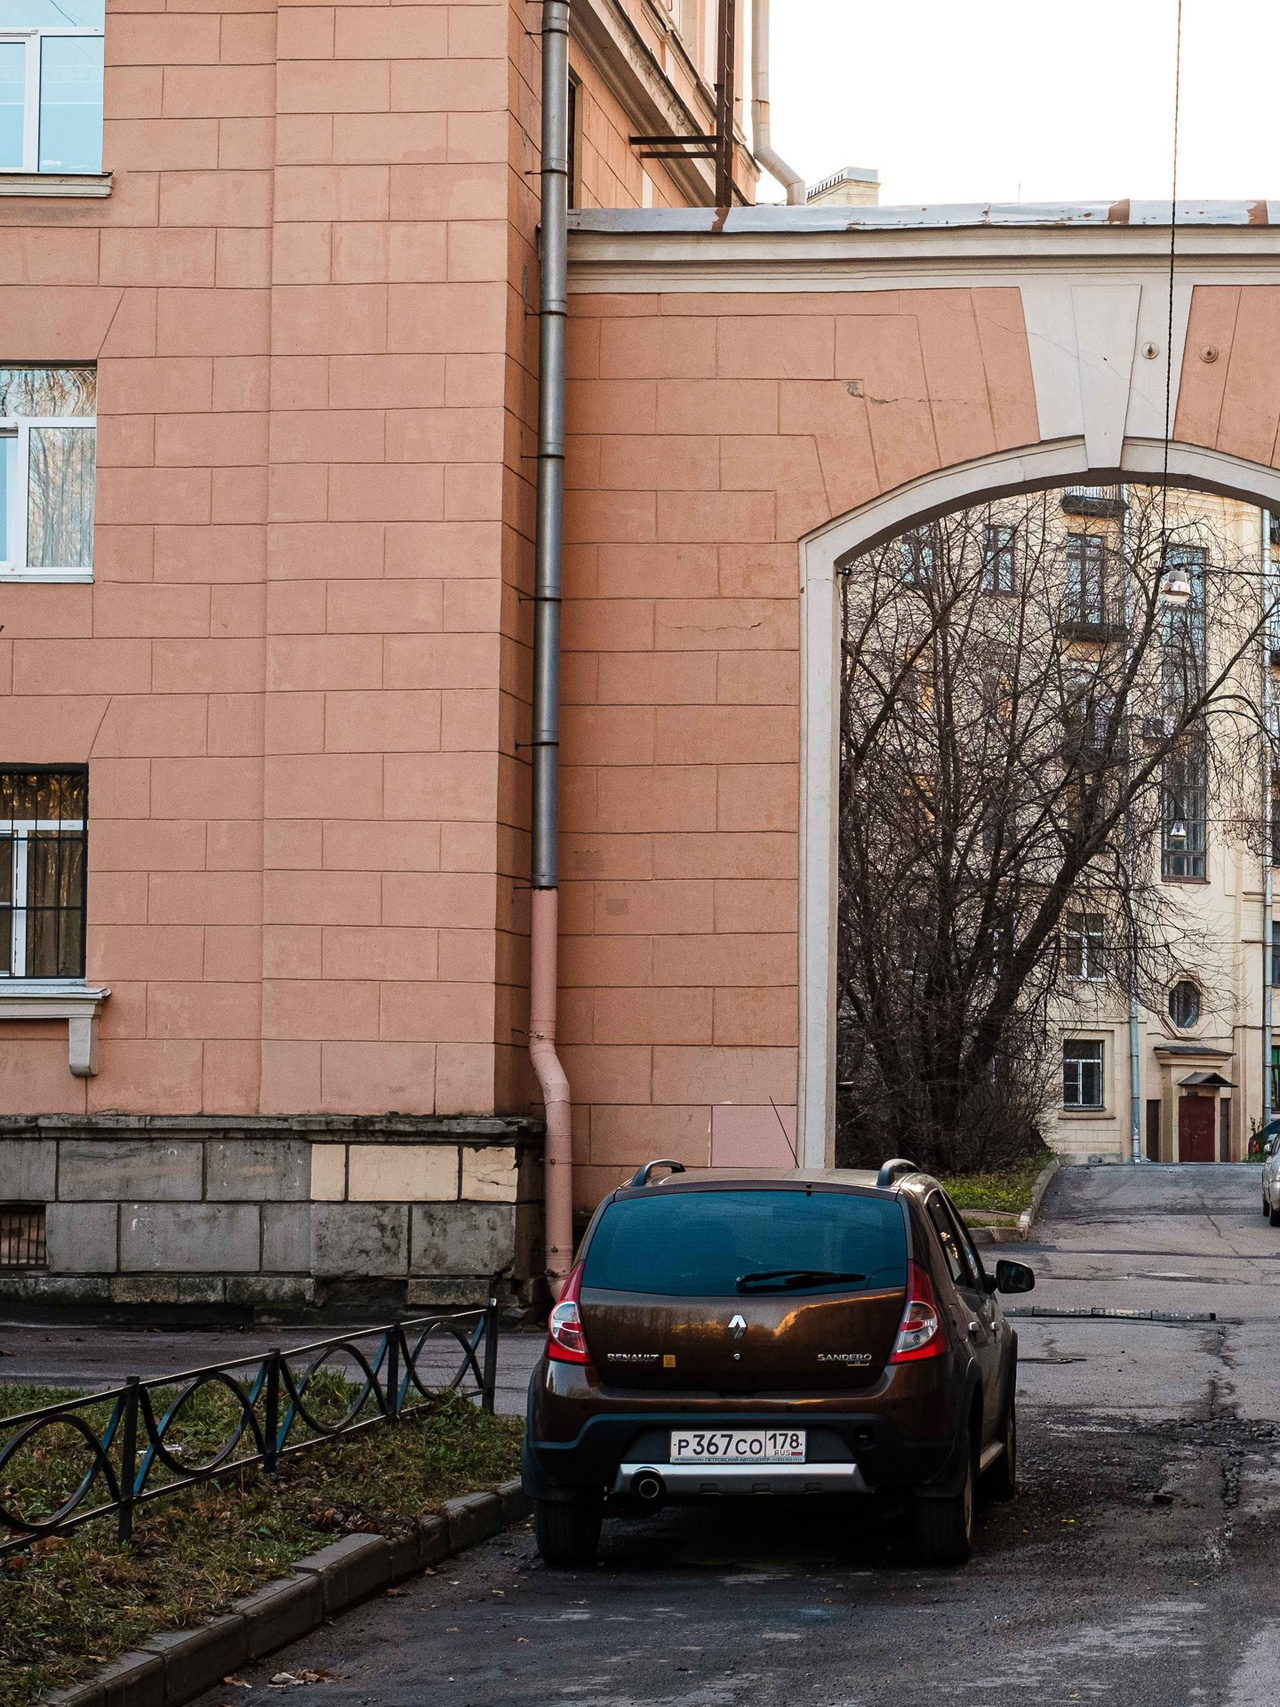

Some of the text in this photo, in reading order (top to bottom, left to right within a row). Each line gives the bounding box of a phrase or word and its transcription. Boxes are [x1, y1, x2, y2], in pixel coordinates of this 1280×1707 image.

[607, 1353, 659, 1362] RENAULT
[817, 1353, 872, 1361] SANDERO
[768, 1433, 800, 1449] 178
